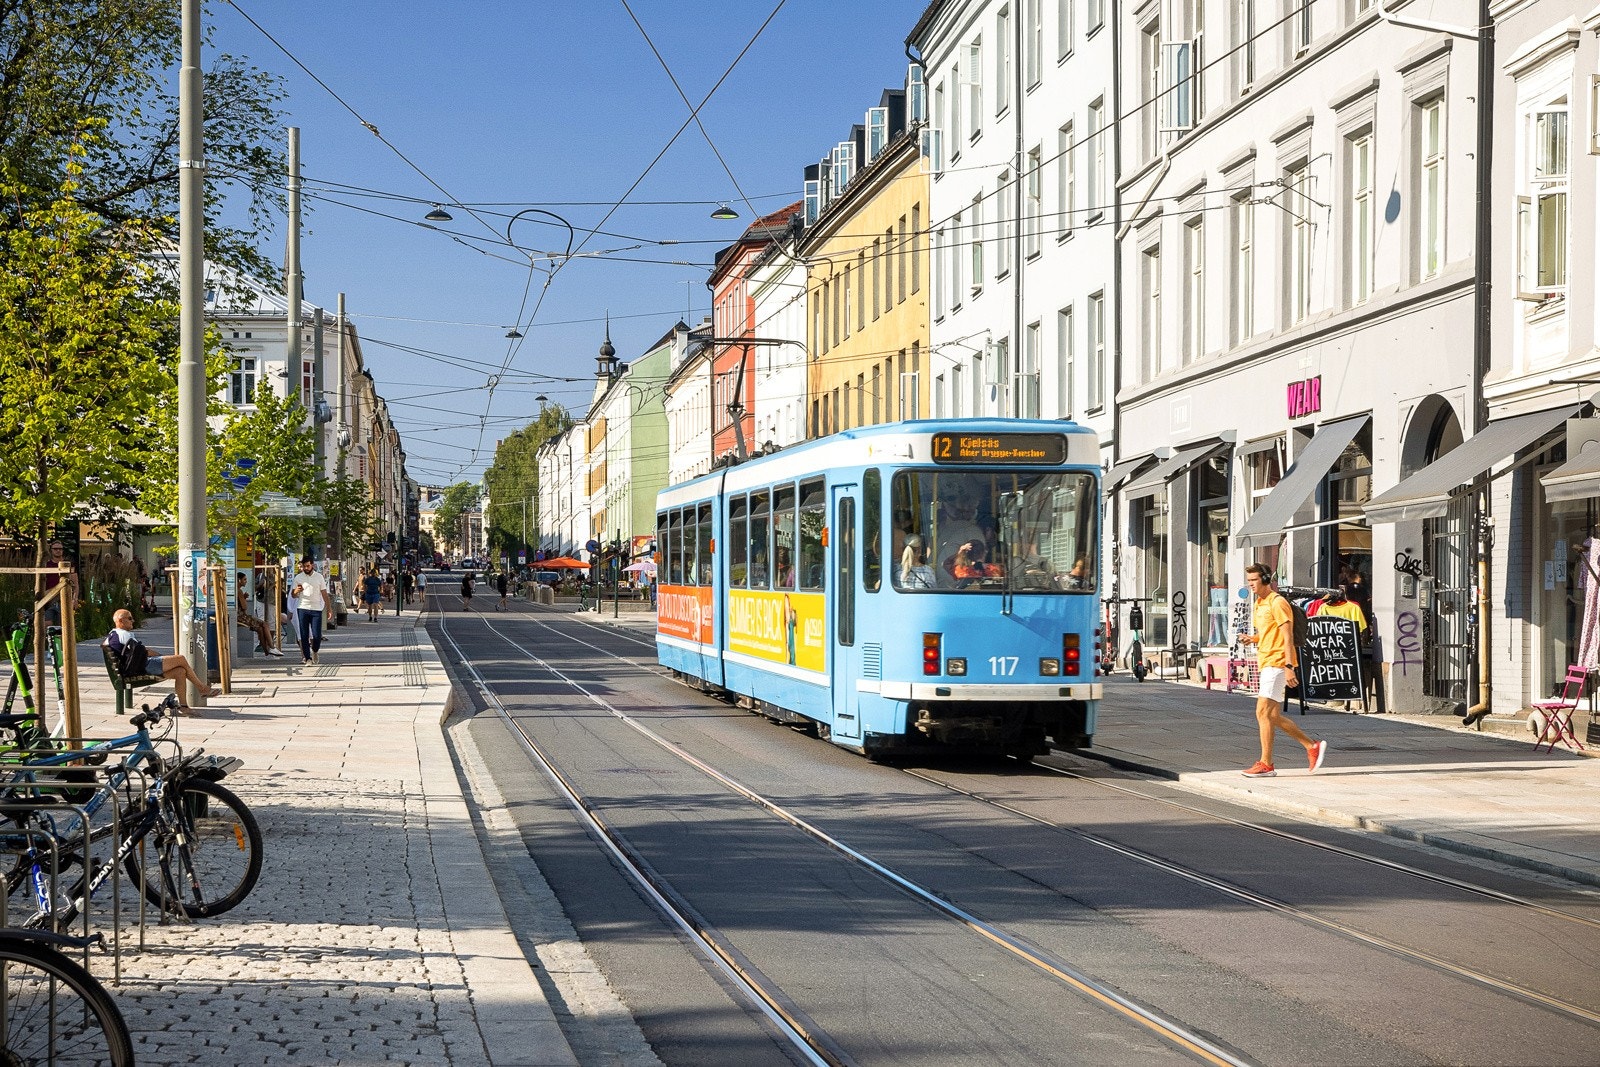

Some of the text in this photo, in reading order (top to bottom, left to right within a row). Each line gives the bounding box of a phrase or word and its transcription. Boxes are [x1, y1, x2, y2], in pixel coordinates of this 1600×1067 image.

[1287, 375, 1321, 420] WEAR
[933, 437, 1000, 457] 12 Kjelsås
[729, 596, 783, 641] SUMMER IS BACK
[809, 618, 822, 637] OSLO
[1306, 635, 1347, 649] WEAR
[988, 656, 1019, 676] 117
[1312, 650, 1321, 663] by
[1309, 661, 1354, 684] ÅPENT
[89, 836, 133, 891] DIAMNT
